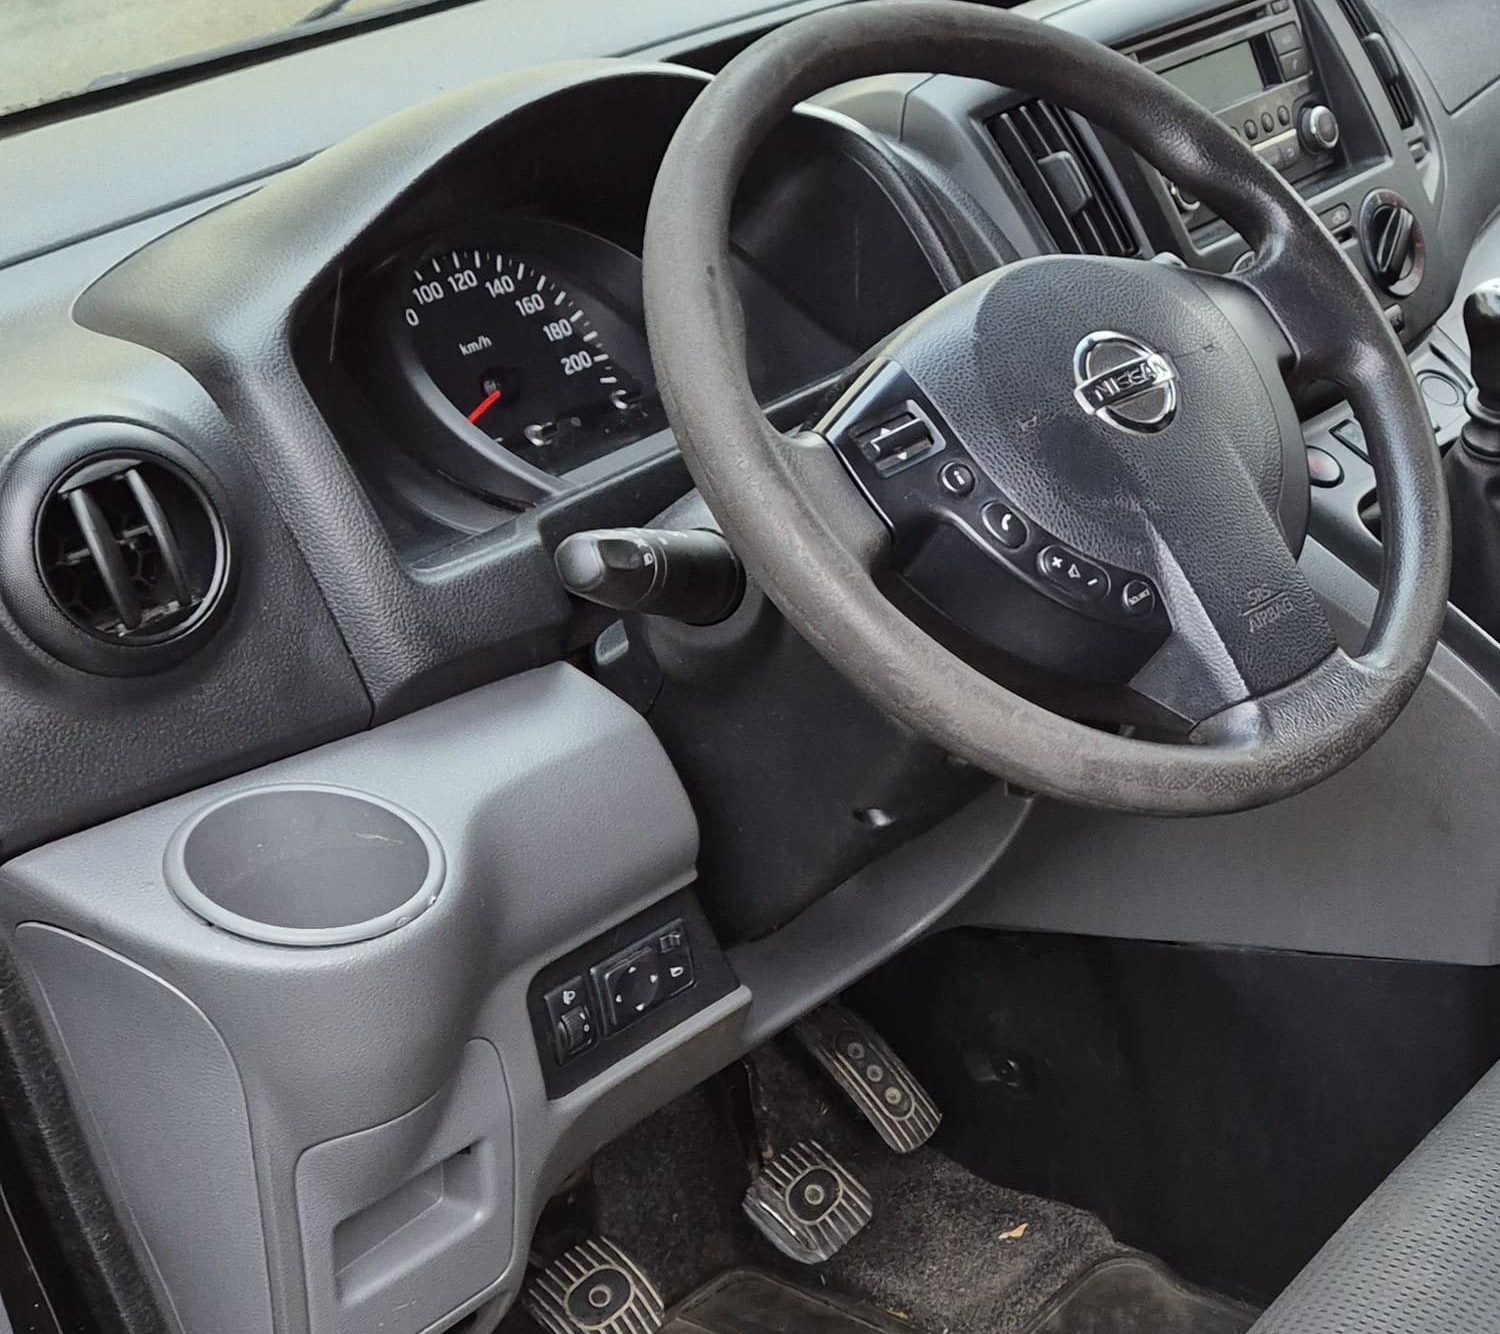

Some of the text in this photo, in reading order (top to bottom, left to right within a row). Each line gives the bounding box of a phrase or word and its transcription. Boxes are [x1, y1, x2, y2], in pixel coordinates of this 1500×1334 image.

[447, 269, 478, 292] 120
[485, 275, 515, 298] 140
[412, 281, 444, 305] 100
[515, 293, 545, 317] 160
[405, 308, 419, 326] 0
[543, 318, 573, 342] 180
[459, 335, 492, 356] km/h
[560, 350, 592, 375] 200
[1094, 357, 1171, 401] NISSAN
[1249, 597, 1293, 633] AIRBAG
